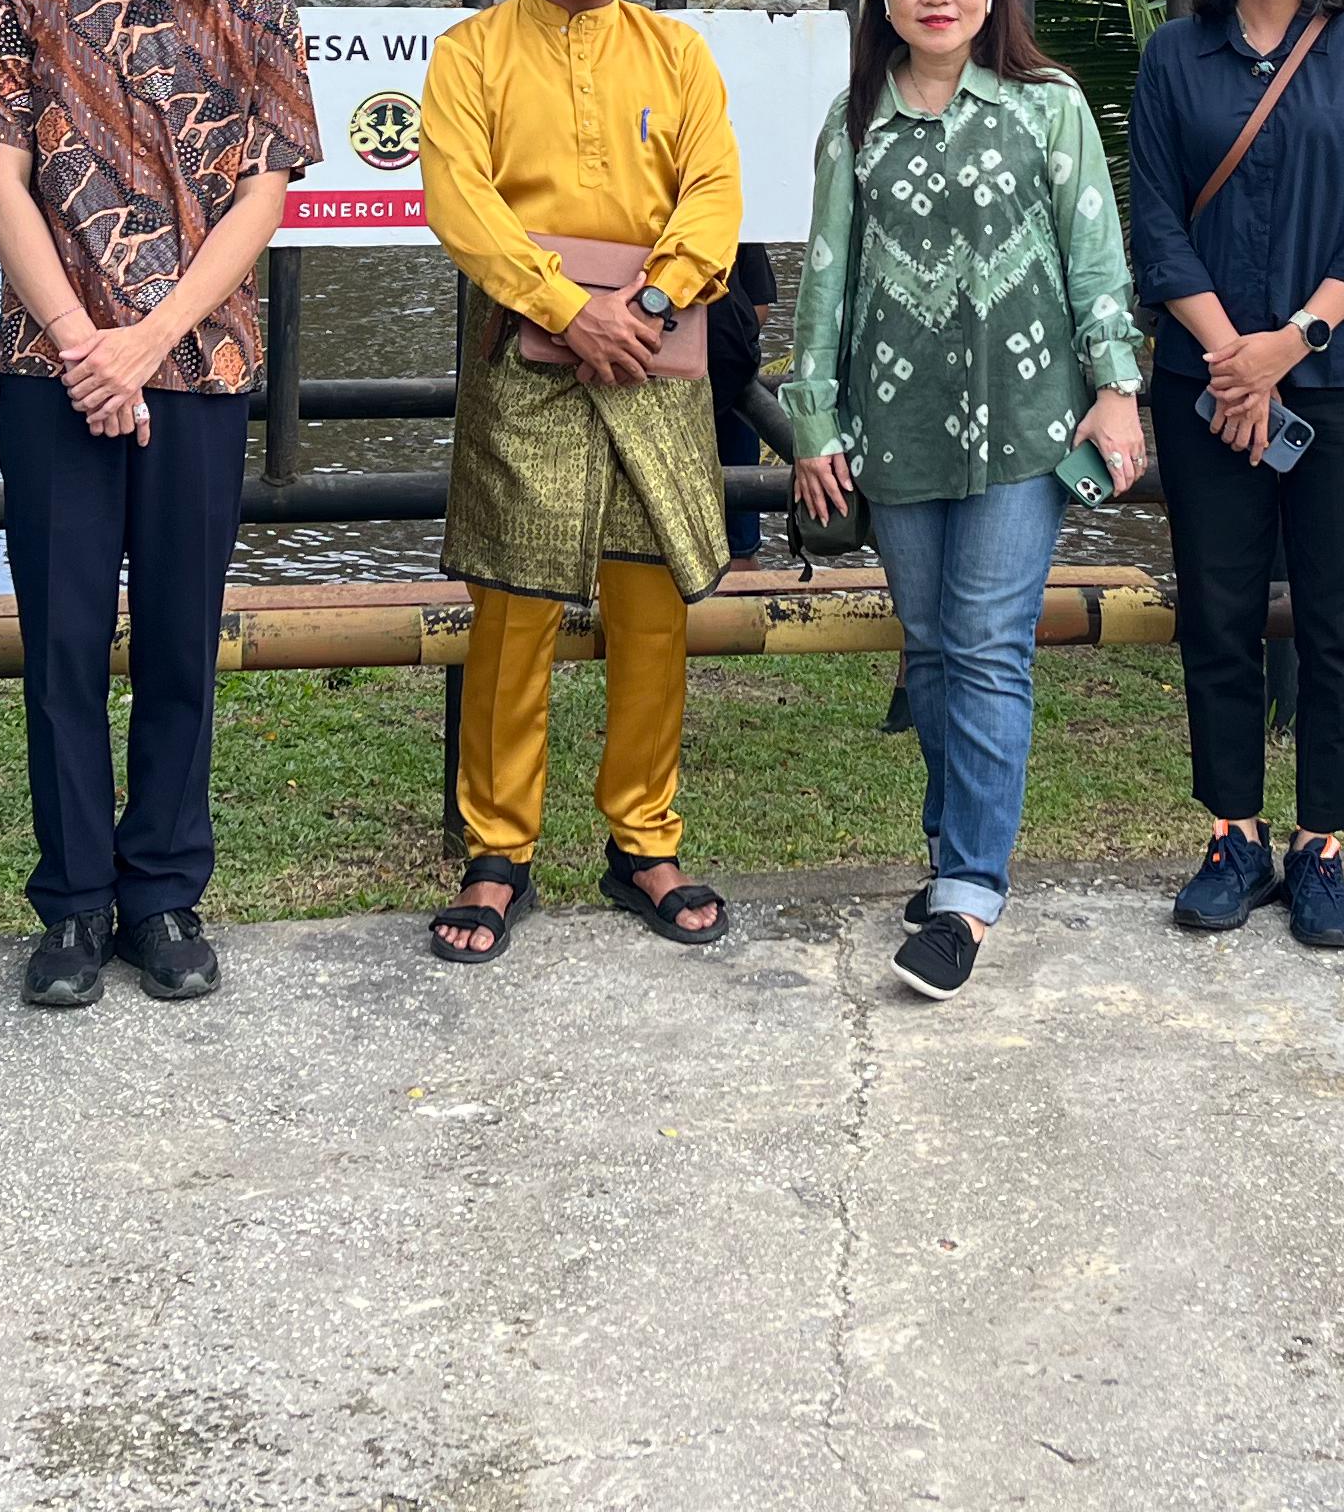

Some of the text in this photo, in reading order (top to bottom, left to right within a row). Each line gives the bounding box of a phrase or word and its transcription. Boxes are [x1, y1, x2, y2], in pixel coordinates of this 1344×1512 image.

[305, 35, 428, 61] ESA WI
[298, 201, 421, 218] SINERGI M
